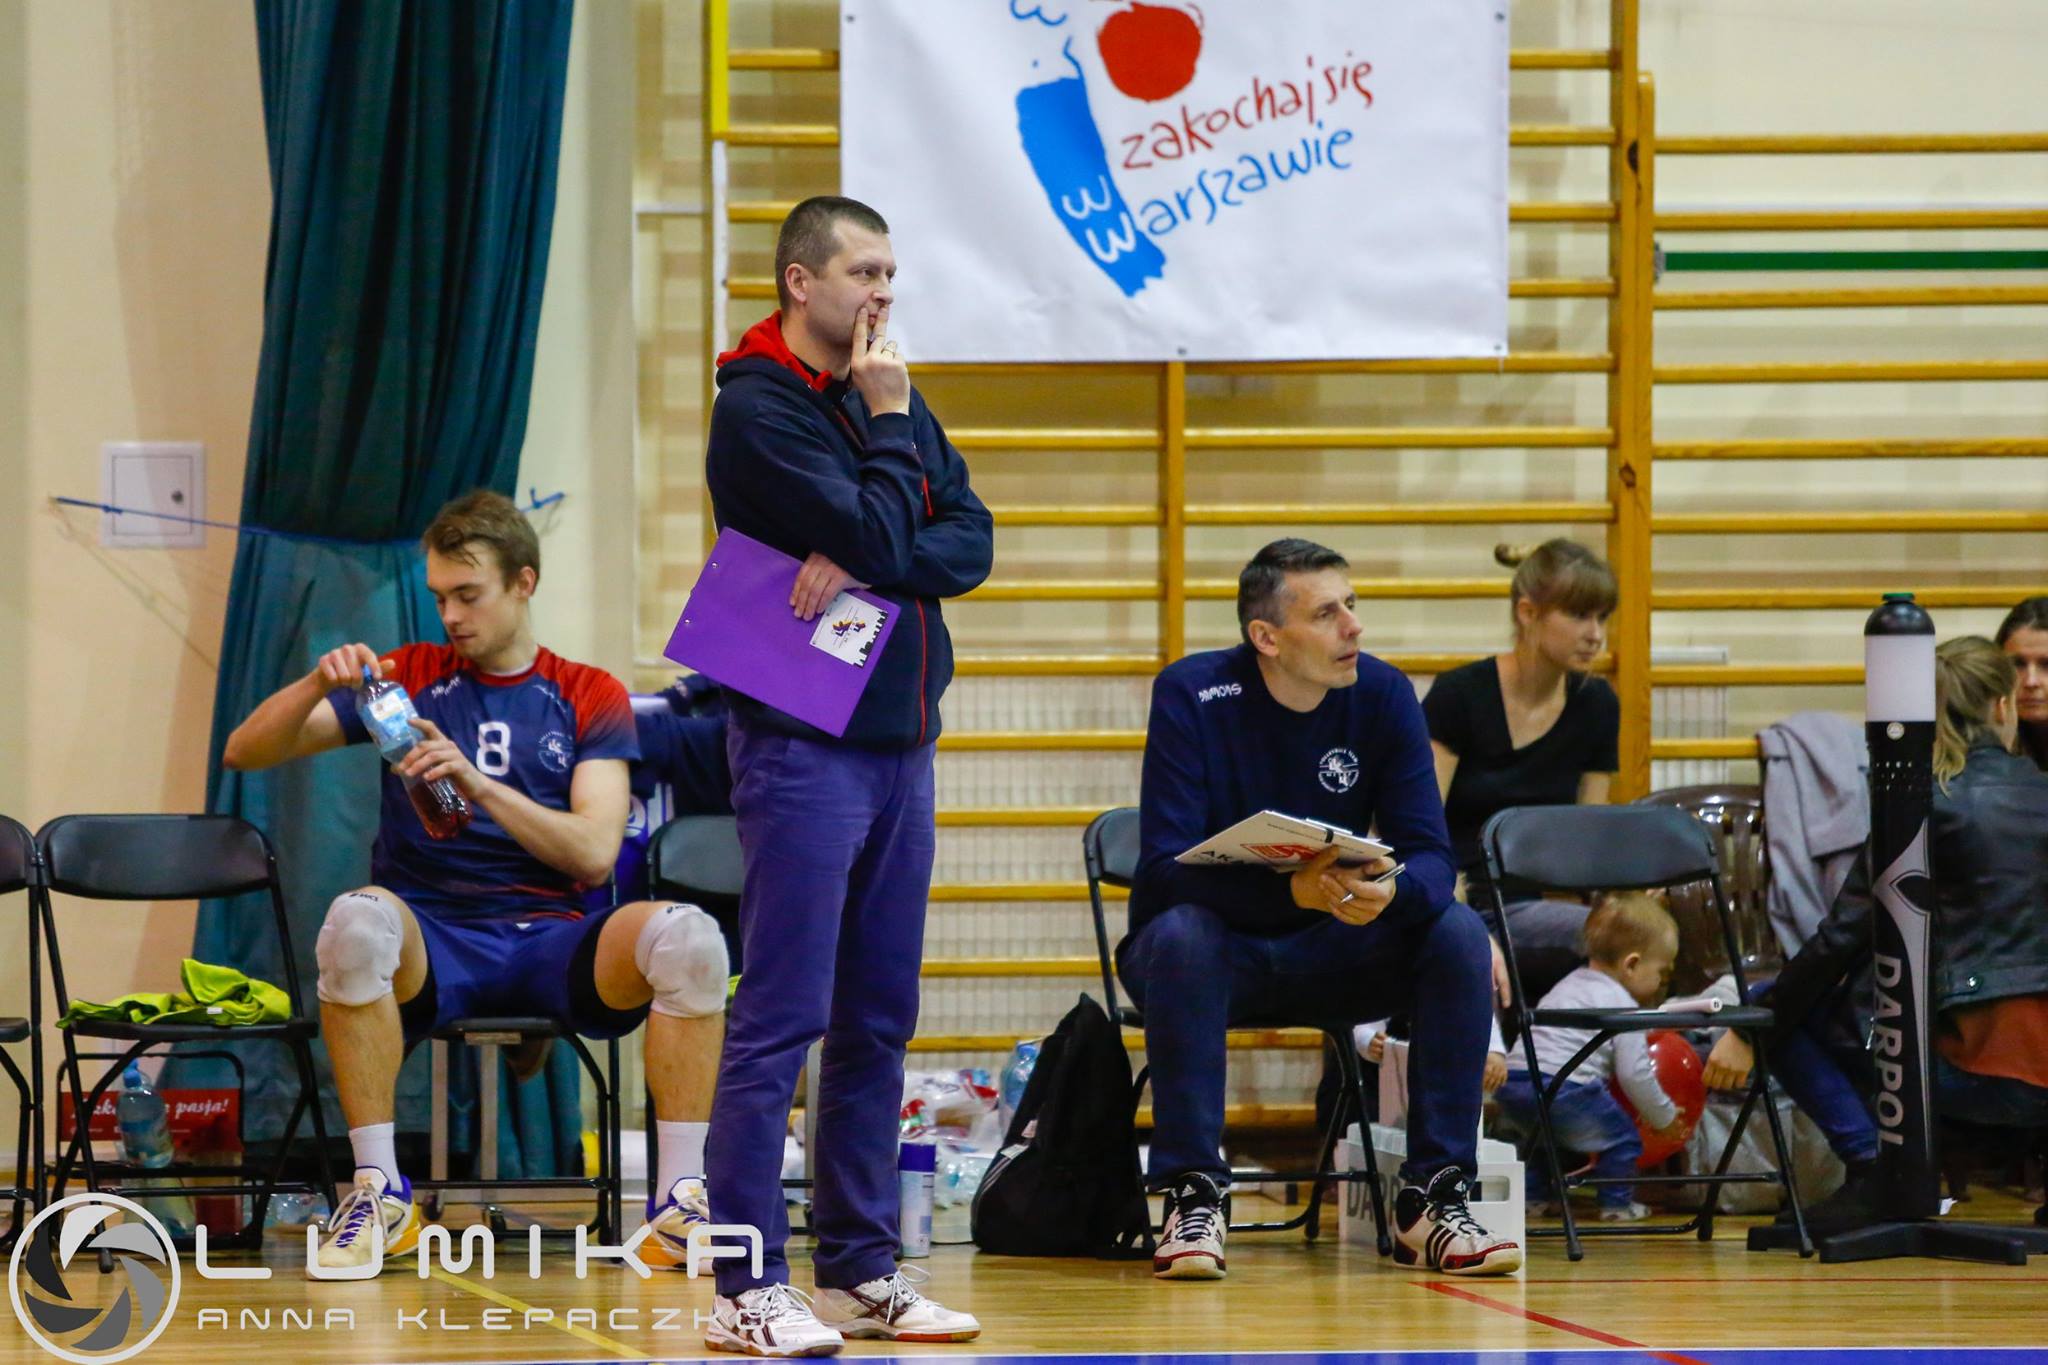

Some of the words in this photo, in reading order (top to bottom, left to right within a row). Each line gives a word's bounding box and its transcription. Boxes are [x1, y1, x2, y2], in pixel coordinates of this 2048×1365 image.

[1120, 54, 1315, 170] zakochaj
[1323, 50, 1374, 110] się
[476, 721, 511, 776] 8
[1873, 952, 1904, 1154] DARPOL
